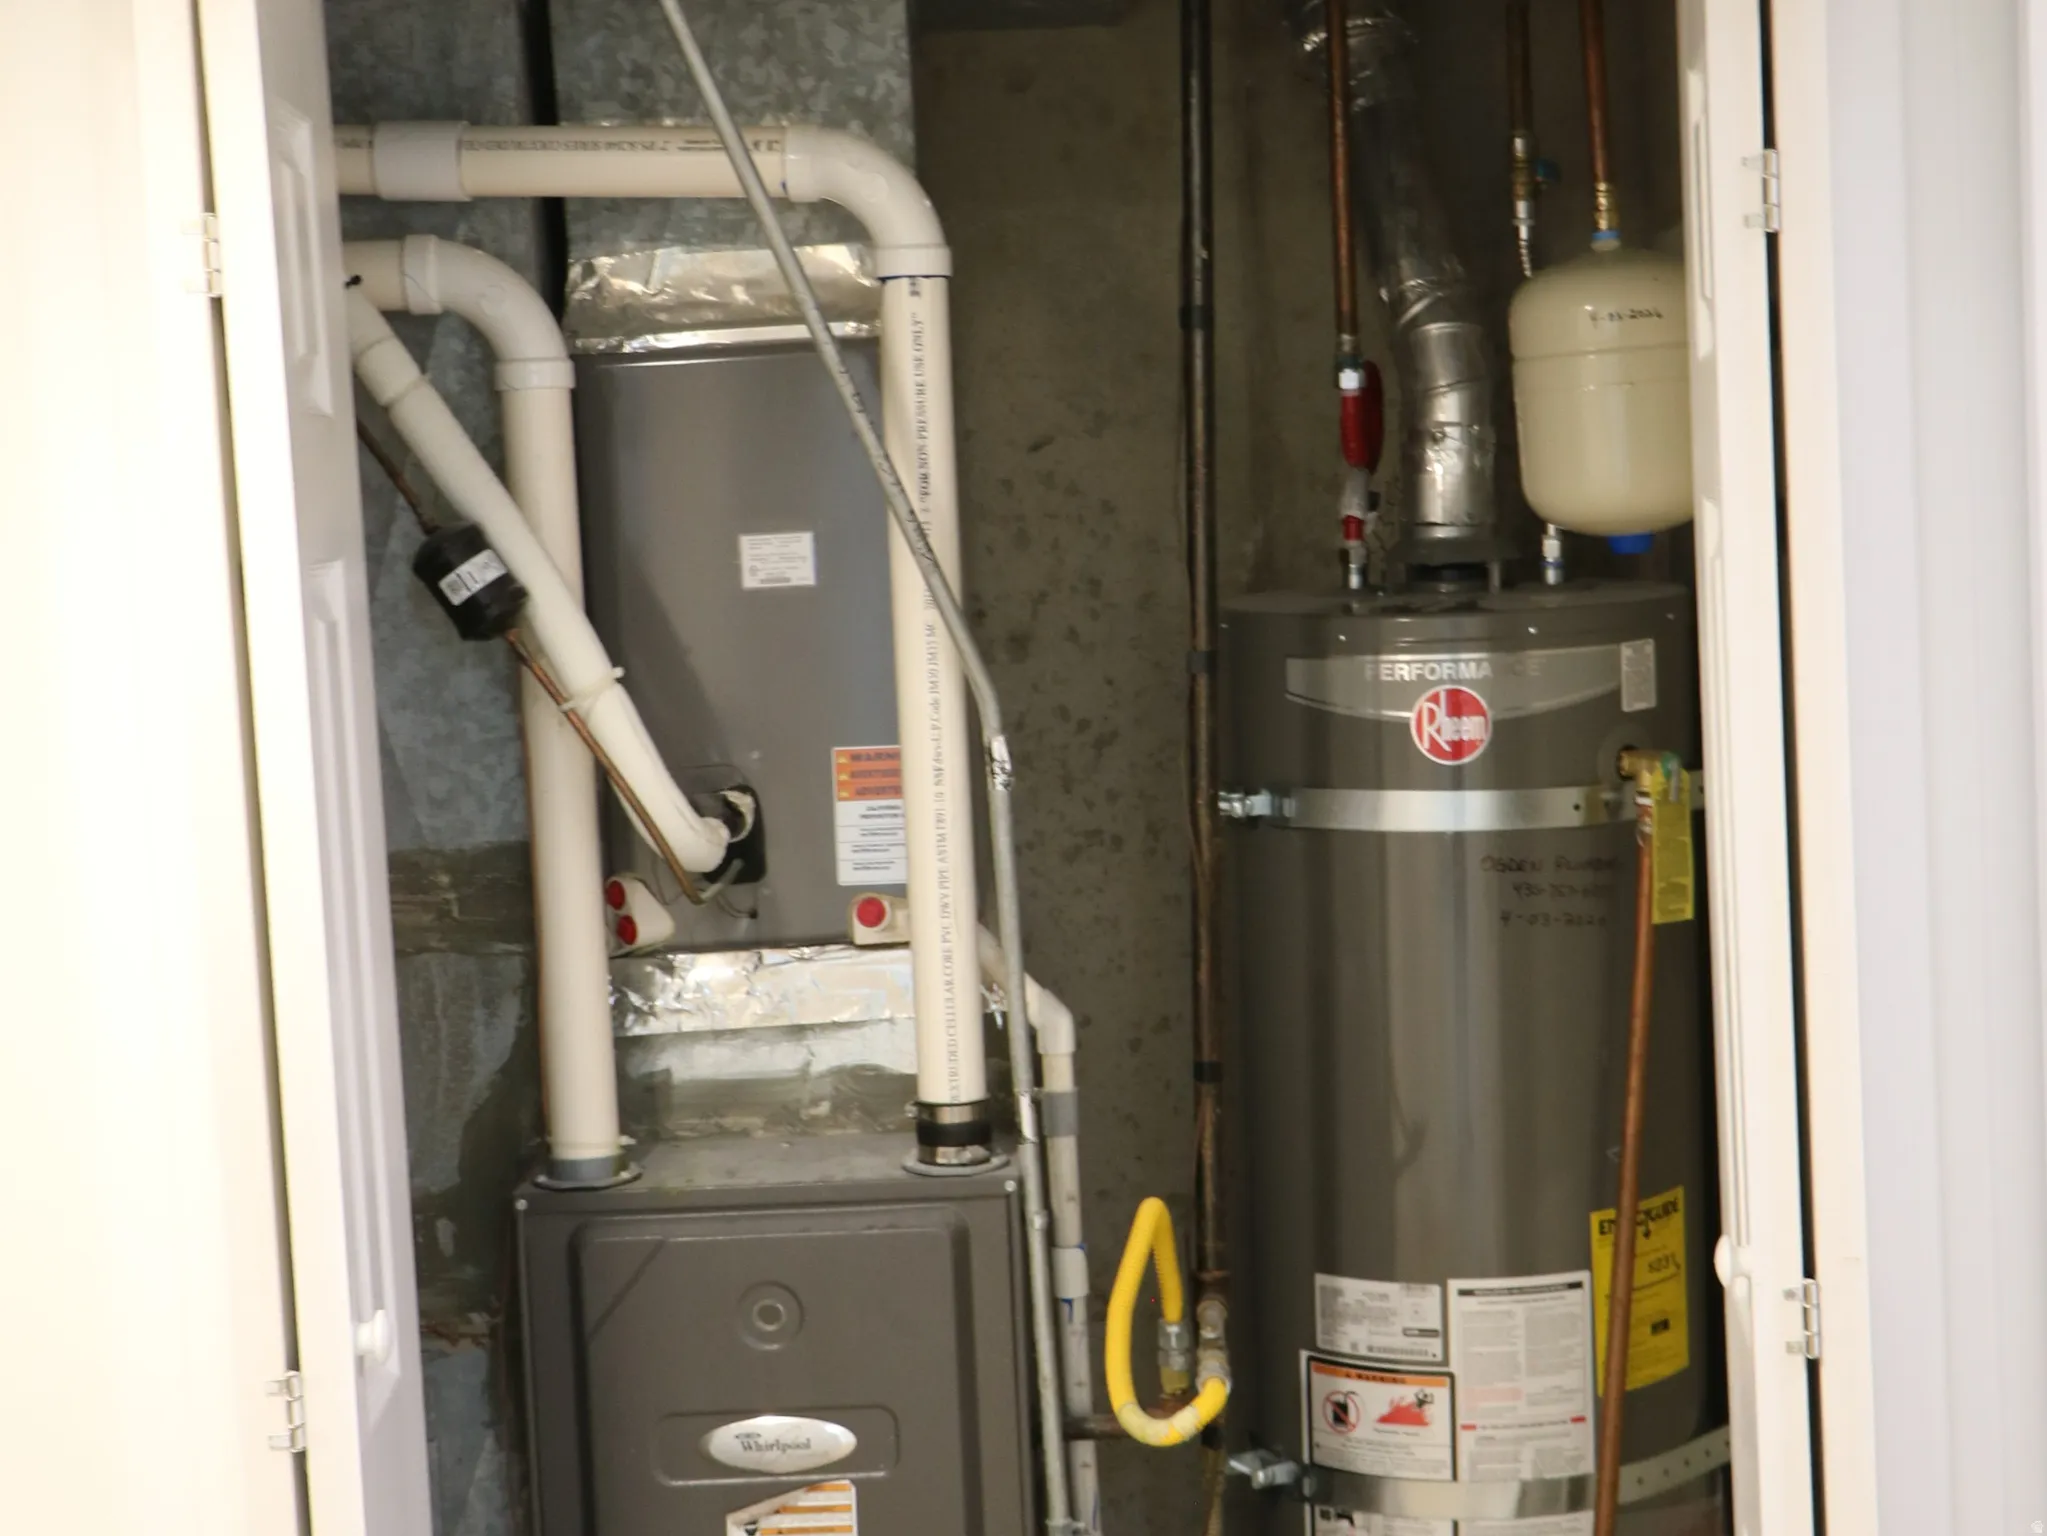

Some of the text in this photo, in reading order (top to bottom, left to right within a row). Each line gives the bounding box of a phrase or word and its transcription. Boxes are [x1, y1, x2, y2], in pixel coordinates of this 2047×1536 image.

[912, 355, 926, 377] USE
[1421, 690, 1487, 752] Rheem
[935, 833, 949, 864] ASTM
[937, 869, 951, 890] PIPE
[938, 892, 952, 919] DWV
[939, 922, 953, 944] PVC
[940, 947, 953, 977] CORE
[741, 1437, 811, 1454] Whirlpool
